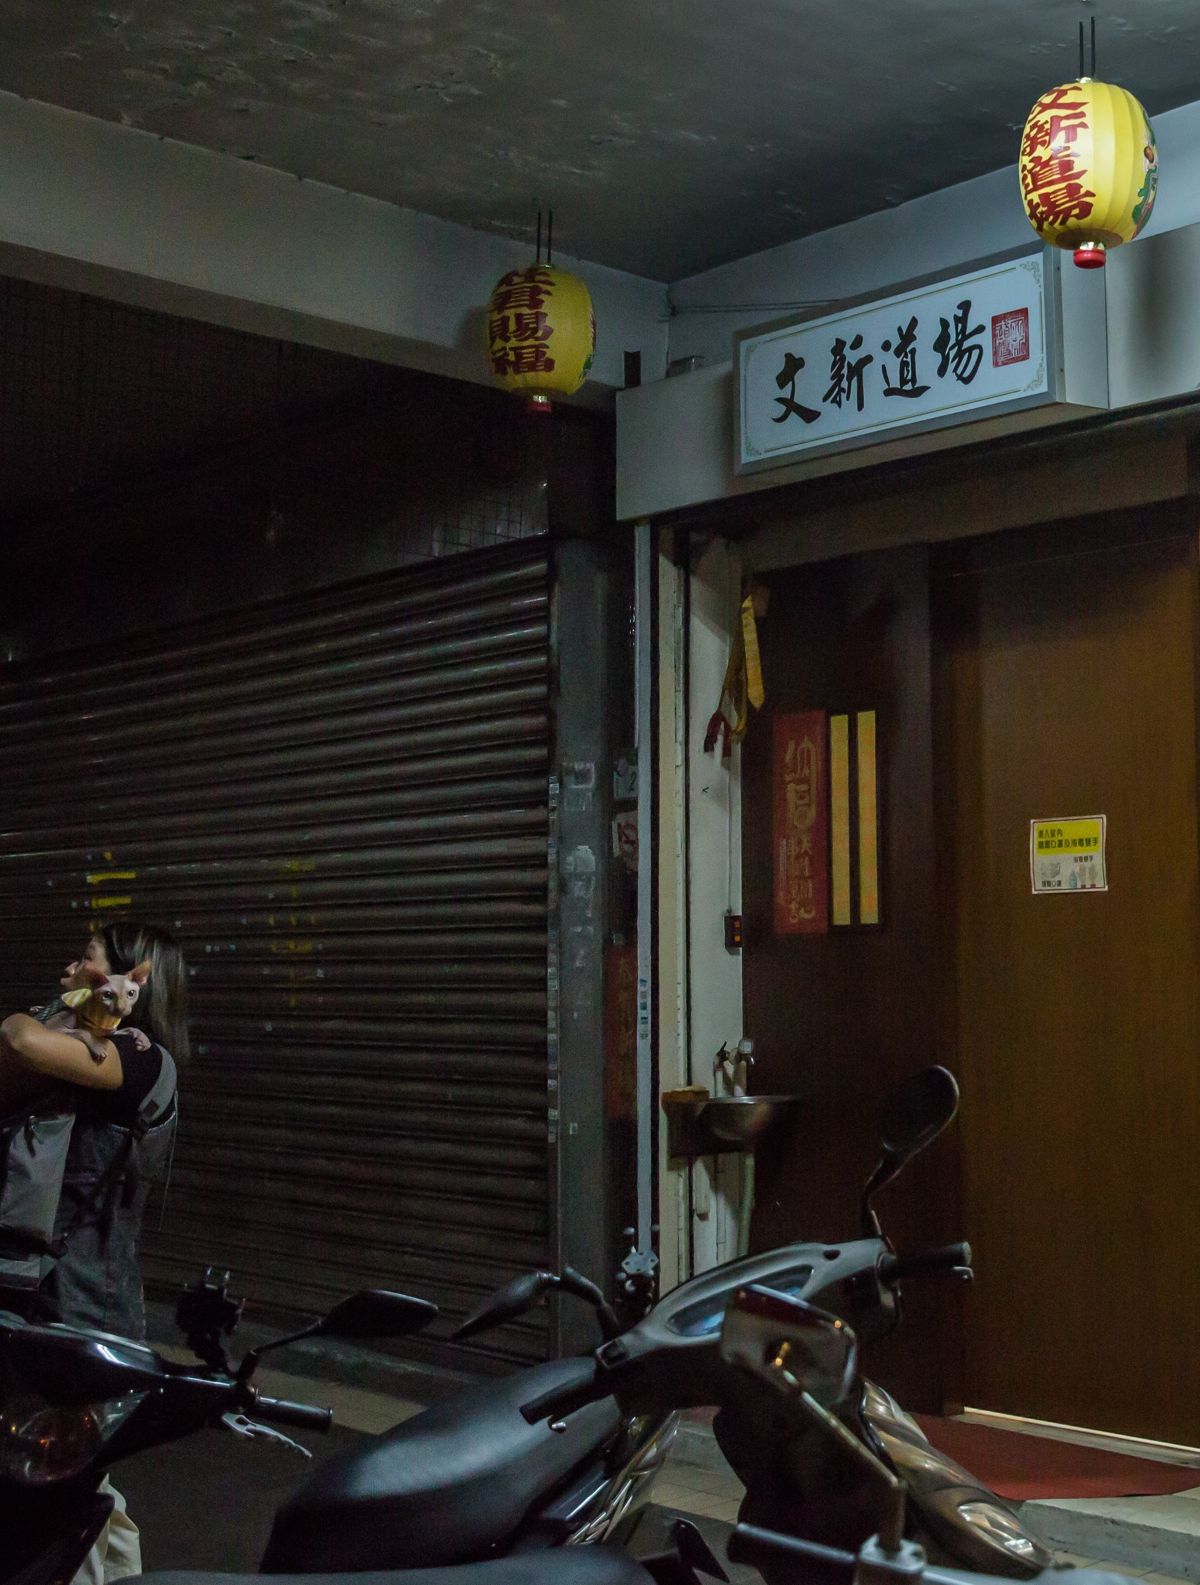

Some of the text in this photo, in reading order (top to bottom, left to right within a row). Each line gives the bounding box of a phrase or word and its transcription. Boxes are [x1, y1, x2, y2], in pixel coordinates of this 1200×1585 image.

[1021, 86, 1096, 233] 文新道場
[771, 299, 987, 425] 文新道場
